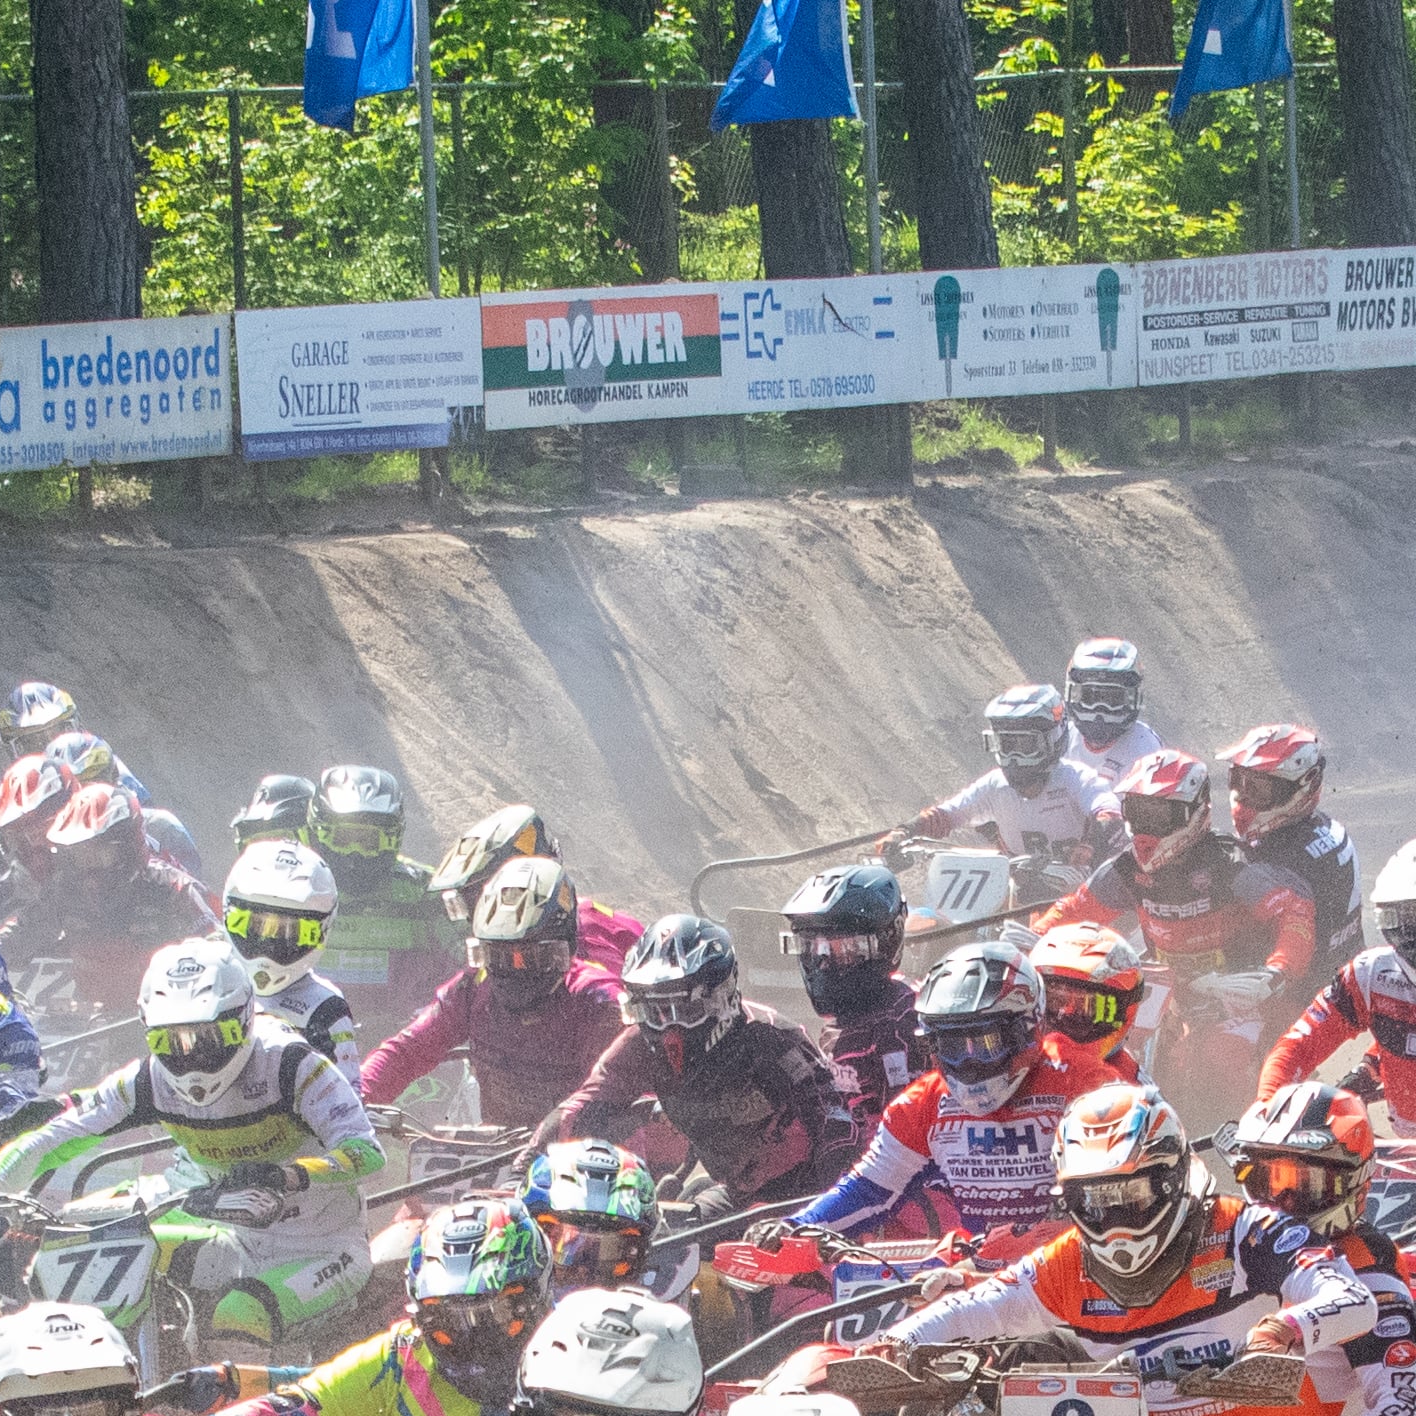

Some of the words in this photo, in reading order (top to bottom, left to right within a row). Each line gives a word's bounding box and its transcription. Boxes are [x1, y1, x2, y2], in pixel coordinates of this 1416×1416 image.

[1254, 255, 1329, 299] MOTORS
[1344, 257, 1415, 292] BROUWER
[1146, 311, 1239, 330] POSTORDER-SERVICE
[1336, 297, 1396, 332] MOTORS
[291, 340, 350, 368] GARAGE
[525, 311, 687, 372] BROUWER
[1151, 336, 1190, 351] HONDA
[1204, 327, 1240, 346] Kawasaki
[1250, 328, 1281, 343] SUZUKI
[41, 327, 220, 389] bredenoord
[278, 375, 361, 419] SNELLER
[528, 383, 643, 407] HORECAGROOTHANDEL
[648, 381, 689, 400] KAMPEN
[748, 378, 784, 400] HEERDE
[43, 384, 222, 431] aggregaten
[169, 961, 205, 978] Arai
[949, 1166, 973, 1179] VAN
[975, 1165, 996, 1178] DEN
[998, 1163, 1051, 1178] HEUVEL
[56, 1244, 146, 1304] 77
[585, 1318, 636, 1339] Arai
